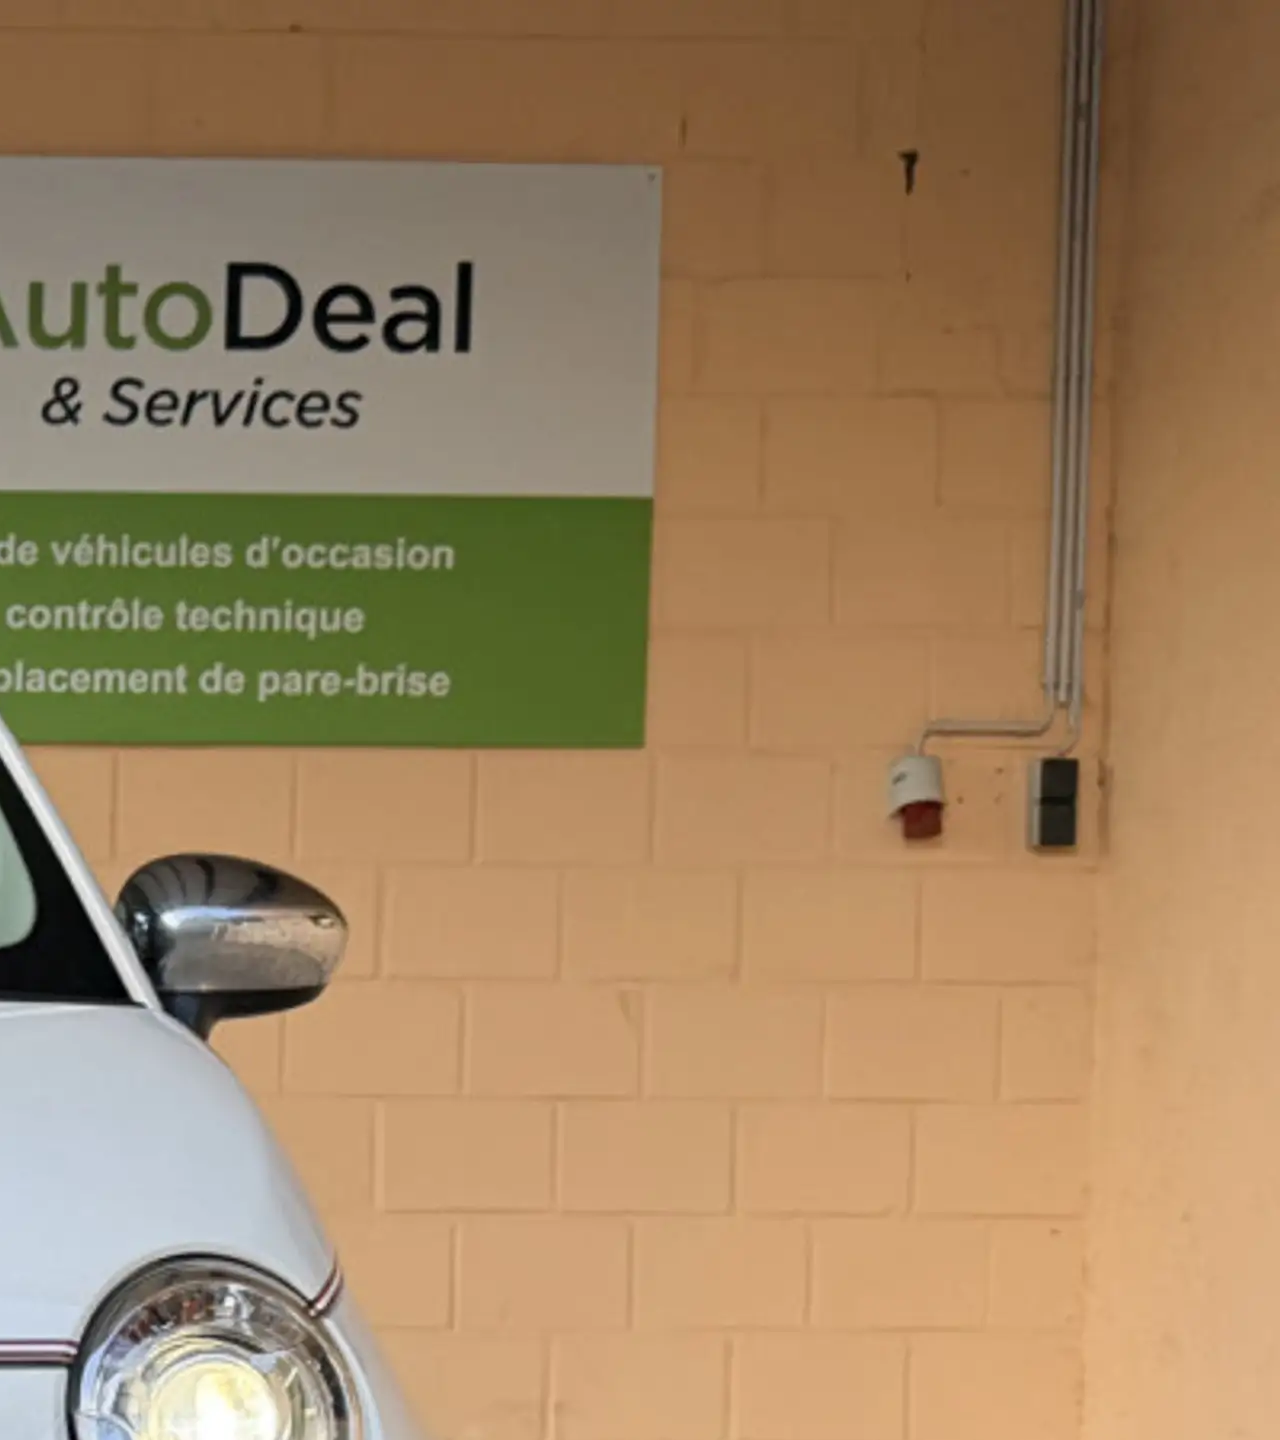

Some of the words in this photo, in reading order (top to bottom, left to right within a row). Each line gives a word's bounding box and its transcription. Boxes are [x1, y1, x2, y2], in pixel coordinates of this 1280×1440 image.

[42, 376, 82, 425] &
[103, 376, 363, 428] Services
[51, 533, 233, 568] véhicules
[246, 535, 455, 570] d'occasion
[6, 597, 165, 631] contrôle
[175, 598, 366, 641] technique
[199, 662, 245, 694] de
[258, 662, 452, 702] pare-brise
